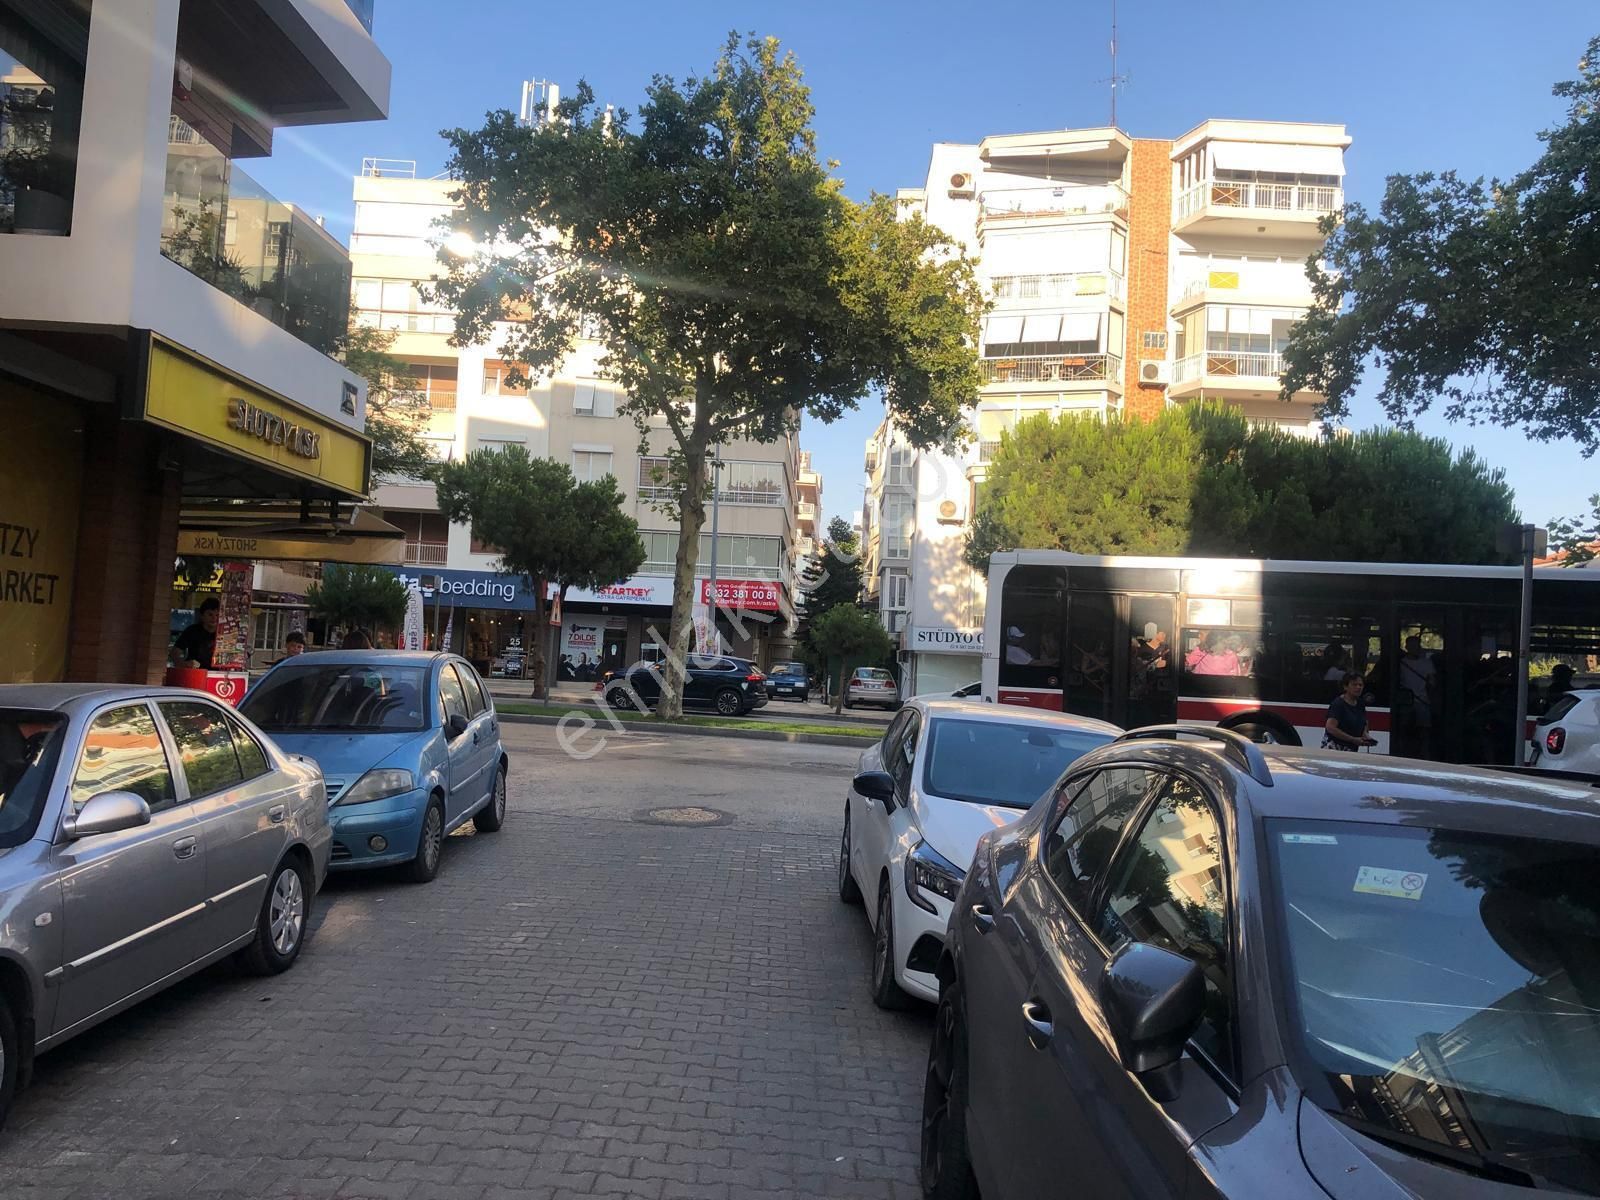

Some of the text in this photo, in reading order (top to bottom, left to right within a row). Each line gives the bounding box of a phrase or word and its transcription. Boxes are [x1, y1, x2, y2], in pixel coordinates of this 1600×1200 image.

[234, 398, 321, 460] SHOTZY KSK
[440, 577, 515, 601] bedding
[600, 586, 650, 597] STARTKEY
[732, 589, 748, 599] 381
[752, 590, 765, 600] 00
[766, 591, 777, 600] 81
[510, 638, 520, 646] 25
[918, 628, 973, 644] STÜDYO
